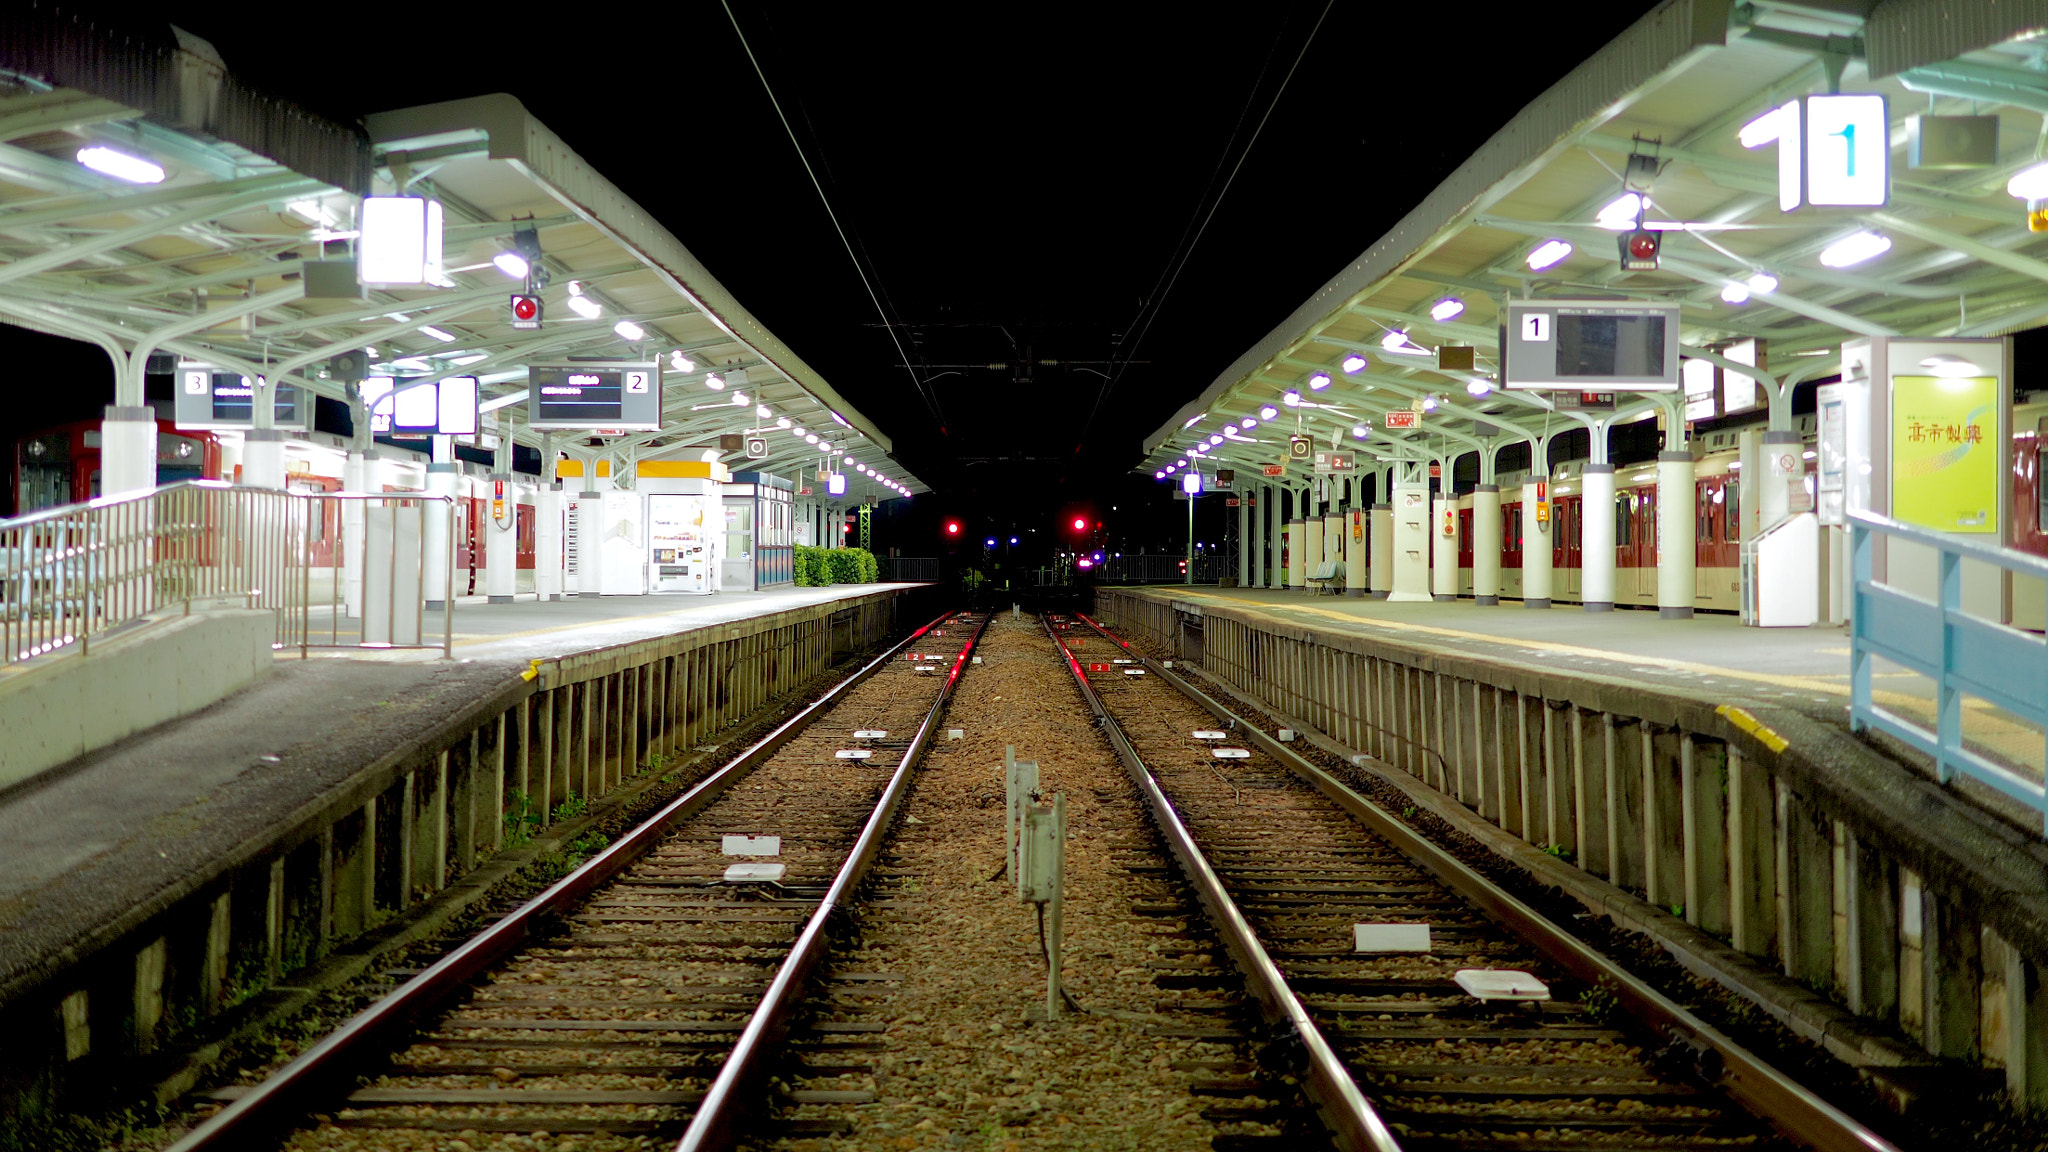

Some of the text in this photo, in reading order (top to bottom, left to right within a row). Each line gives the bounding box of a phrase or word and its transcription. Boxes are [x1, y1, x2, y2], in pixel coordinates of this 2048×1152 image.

[1828, 123, 1856, 177] 1
[1530, 318, 1539, 336] 1
[191, 376, 201, 390] 3
[632, 375, 642, 389] 2
